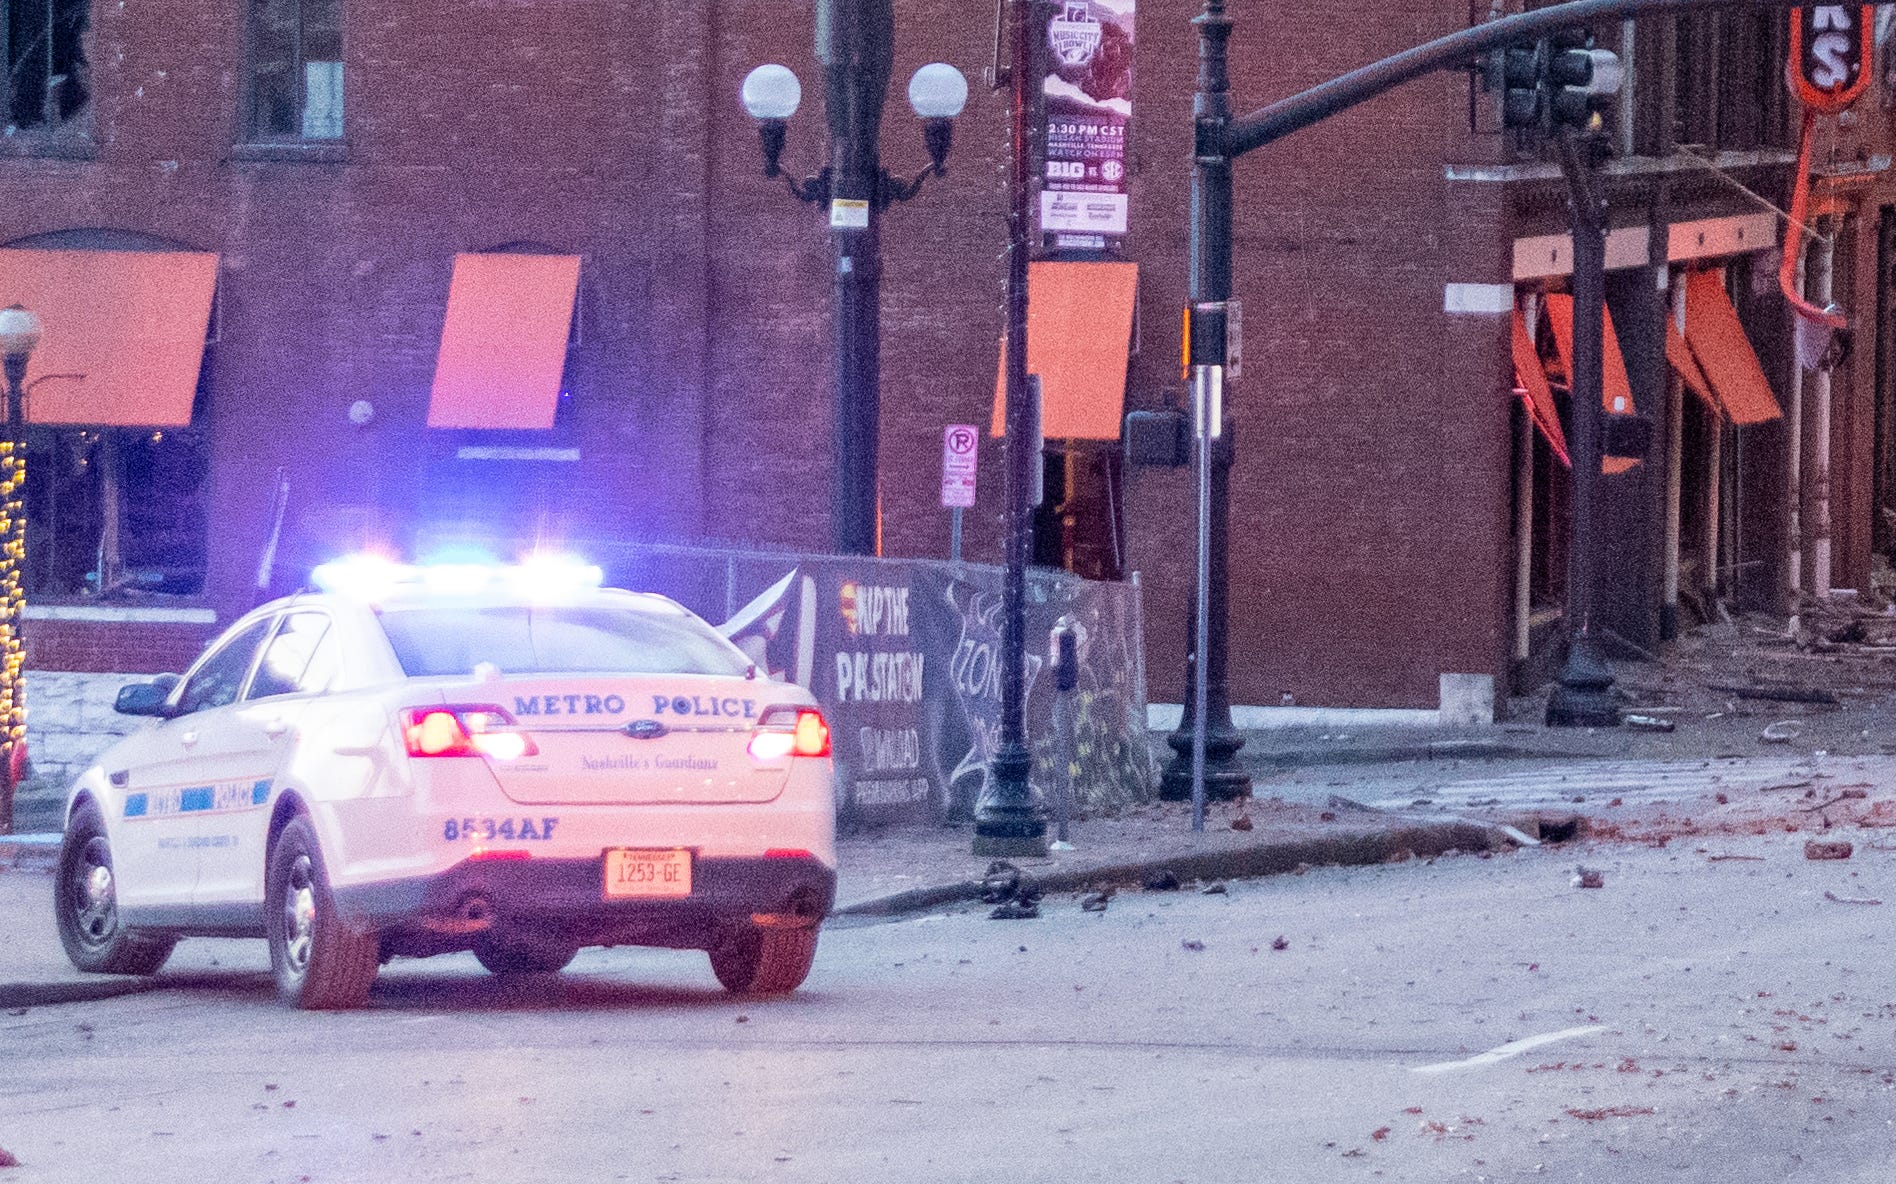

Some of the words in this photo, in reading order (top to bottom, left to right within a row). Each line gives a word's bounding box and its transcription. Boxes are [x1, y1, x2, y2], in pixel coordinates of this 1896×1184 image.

[1048, 123, 1077, 134] 2:30
[1079, 124, 1098, 135] PM
[1100, 125, 1125, 136] CST
[513, 694, 626, 717] METRO
[651, 694, 758, 719] POLICE
[617, 862, 682, 883] 1253-GE
